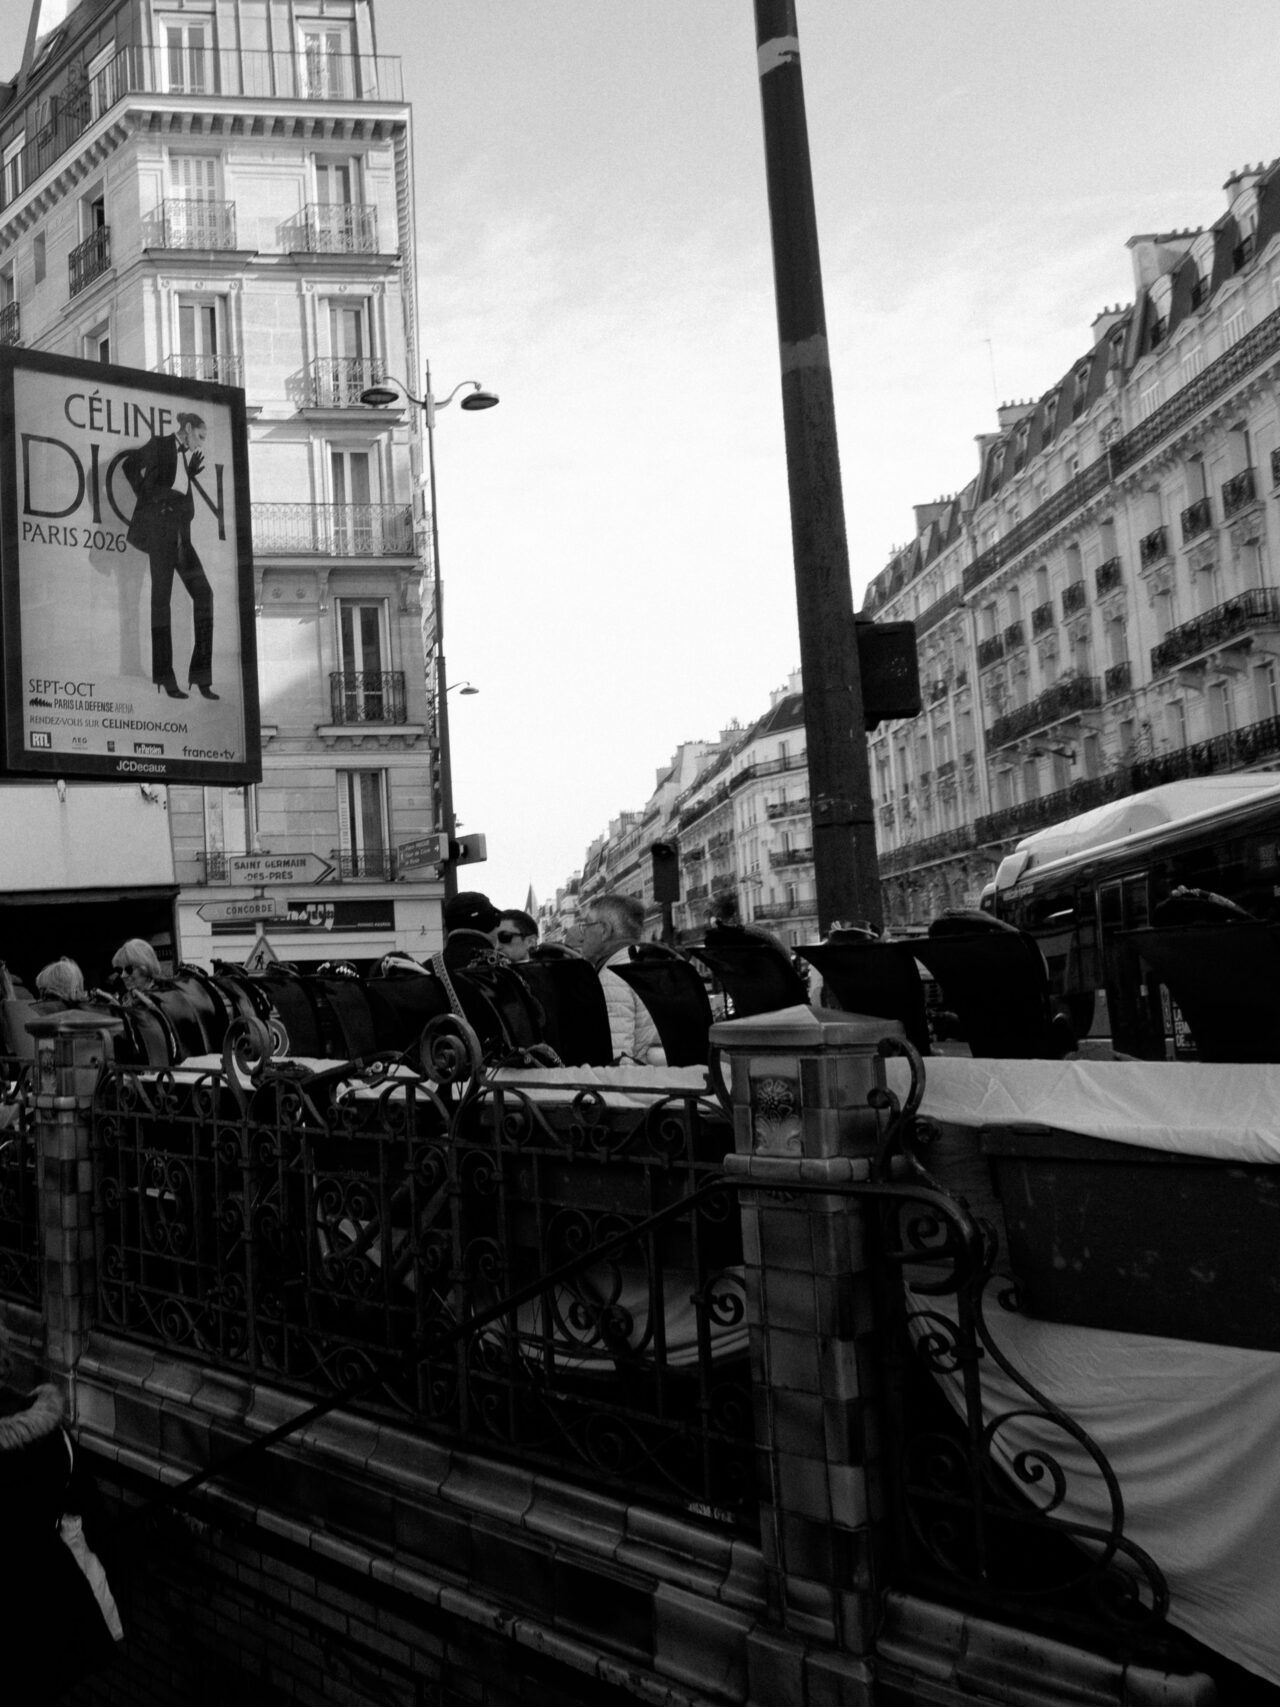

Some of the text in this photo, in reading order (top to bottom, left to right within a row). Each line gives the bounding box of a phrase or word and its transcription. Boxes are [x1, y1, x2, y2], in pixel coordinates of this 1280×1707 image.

[64, 389, 172, 438] CÉLINE
[22, 521, 127, 553] PARIS 2026
[28, 678, 96, 697] SEPT-OCT
[54, 698, 74, 710] PARIS
[75, 699, 84, 711] LA
[84, 701, 114, 713] DEFENSE
[101, 718, 188, 733] CELINEDION.COM
[32, 733, 50, 747] RTL
[116, 760, 166, 773] JCDecaux
[234, 858, 306, 870] SAINT GERMAIN
[226, 903, 272, 915] CONCORDE
